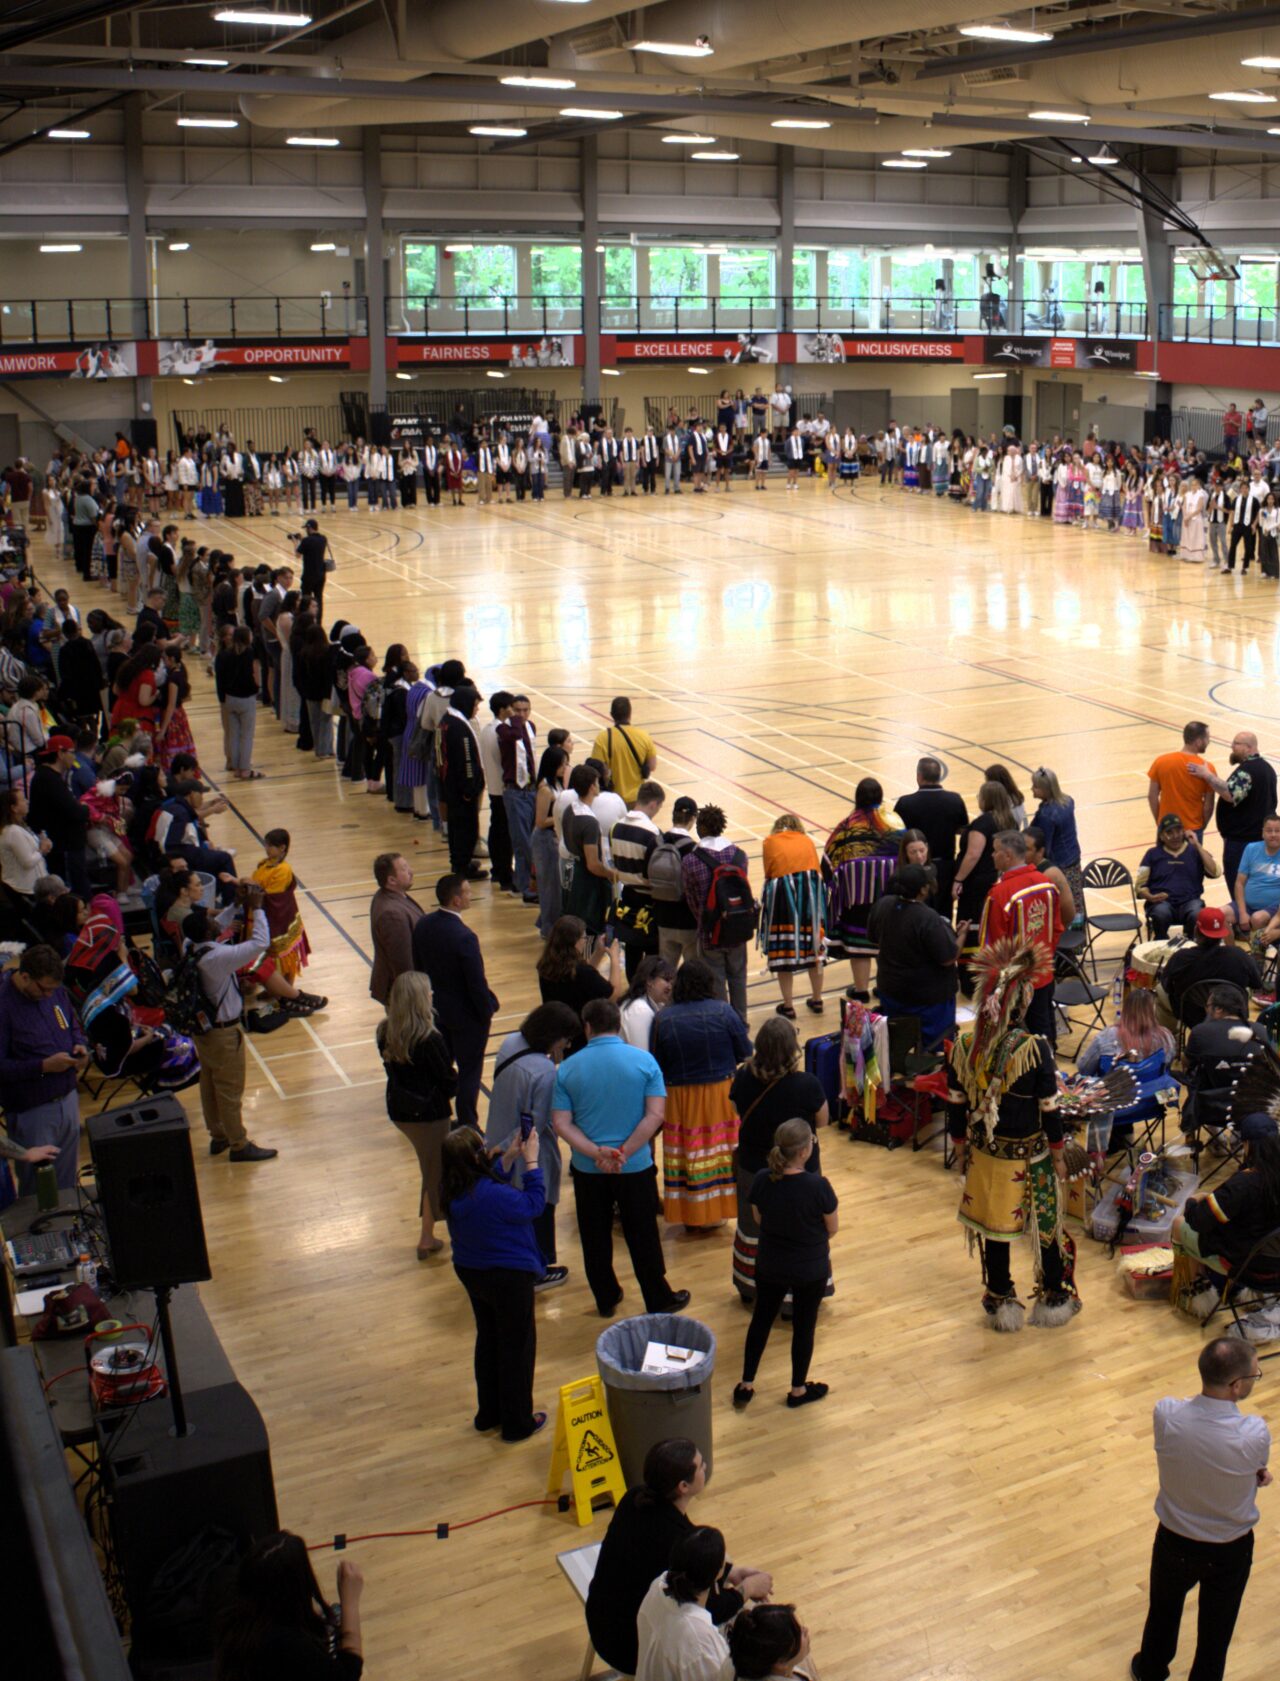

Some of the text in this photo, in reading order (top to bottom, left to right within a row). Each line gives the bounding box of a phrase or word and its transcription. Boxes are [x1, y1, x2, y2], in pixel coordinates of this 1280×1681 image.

[244, 348, 343, 363] OPPORTUNITY
[423, 346, 490, 360] FAIRNESS
[634, 343, 713, 356] EXCELLENCE
[856, 343, 953, 356] INCLUSIVENESS
[571, 1409, 603, 1427] CAUTION
